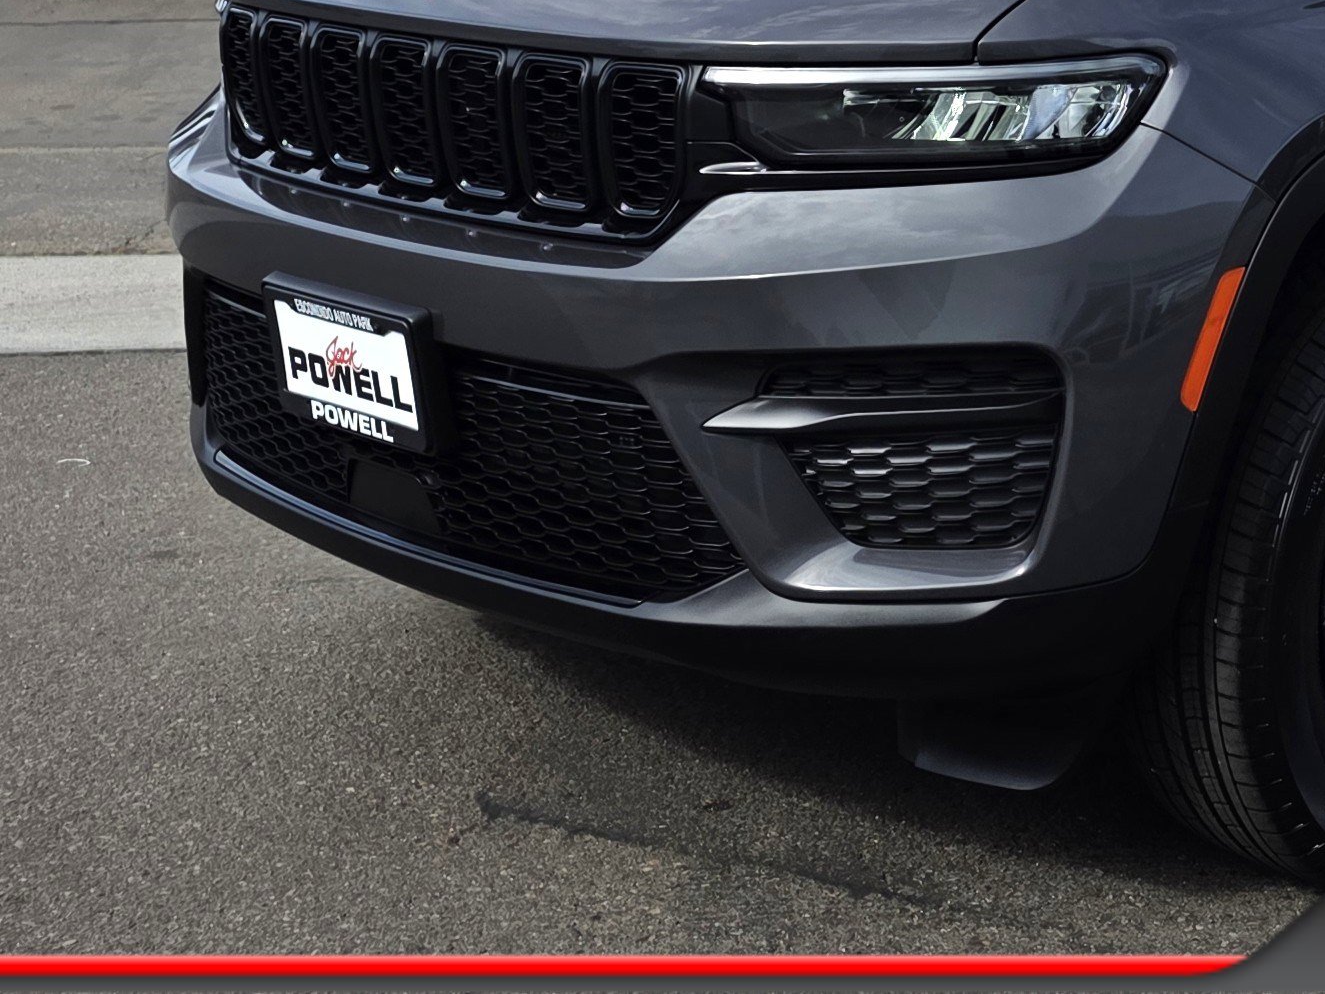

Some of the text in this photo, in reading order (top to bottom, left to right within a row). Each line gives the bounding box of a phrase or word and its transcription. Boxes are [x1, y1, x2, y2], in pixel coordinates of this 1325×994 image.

[325, 335, 363, 379] Jack
[287, 346, 414, 414] POWELL
[310, 399, 395, 444] POWELL
